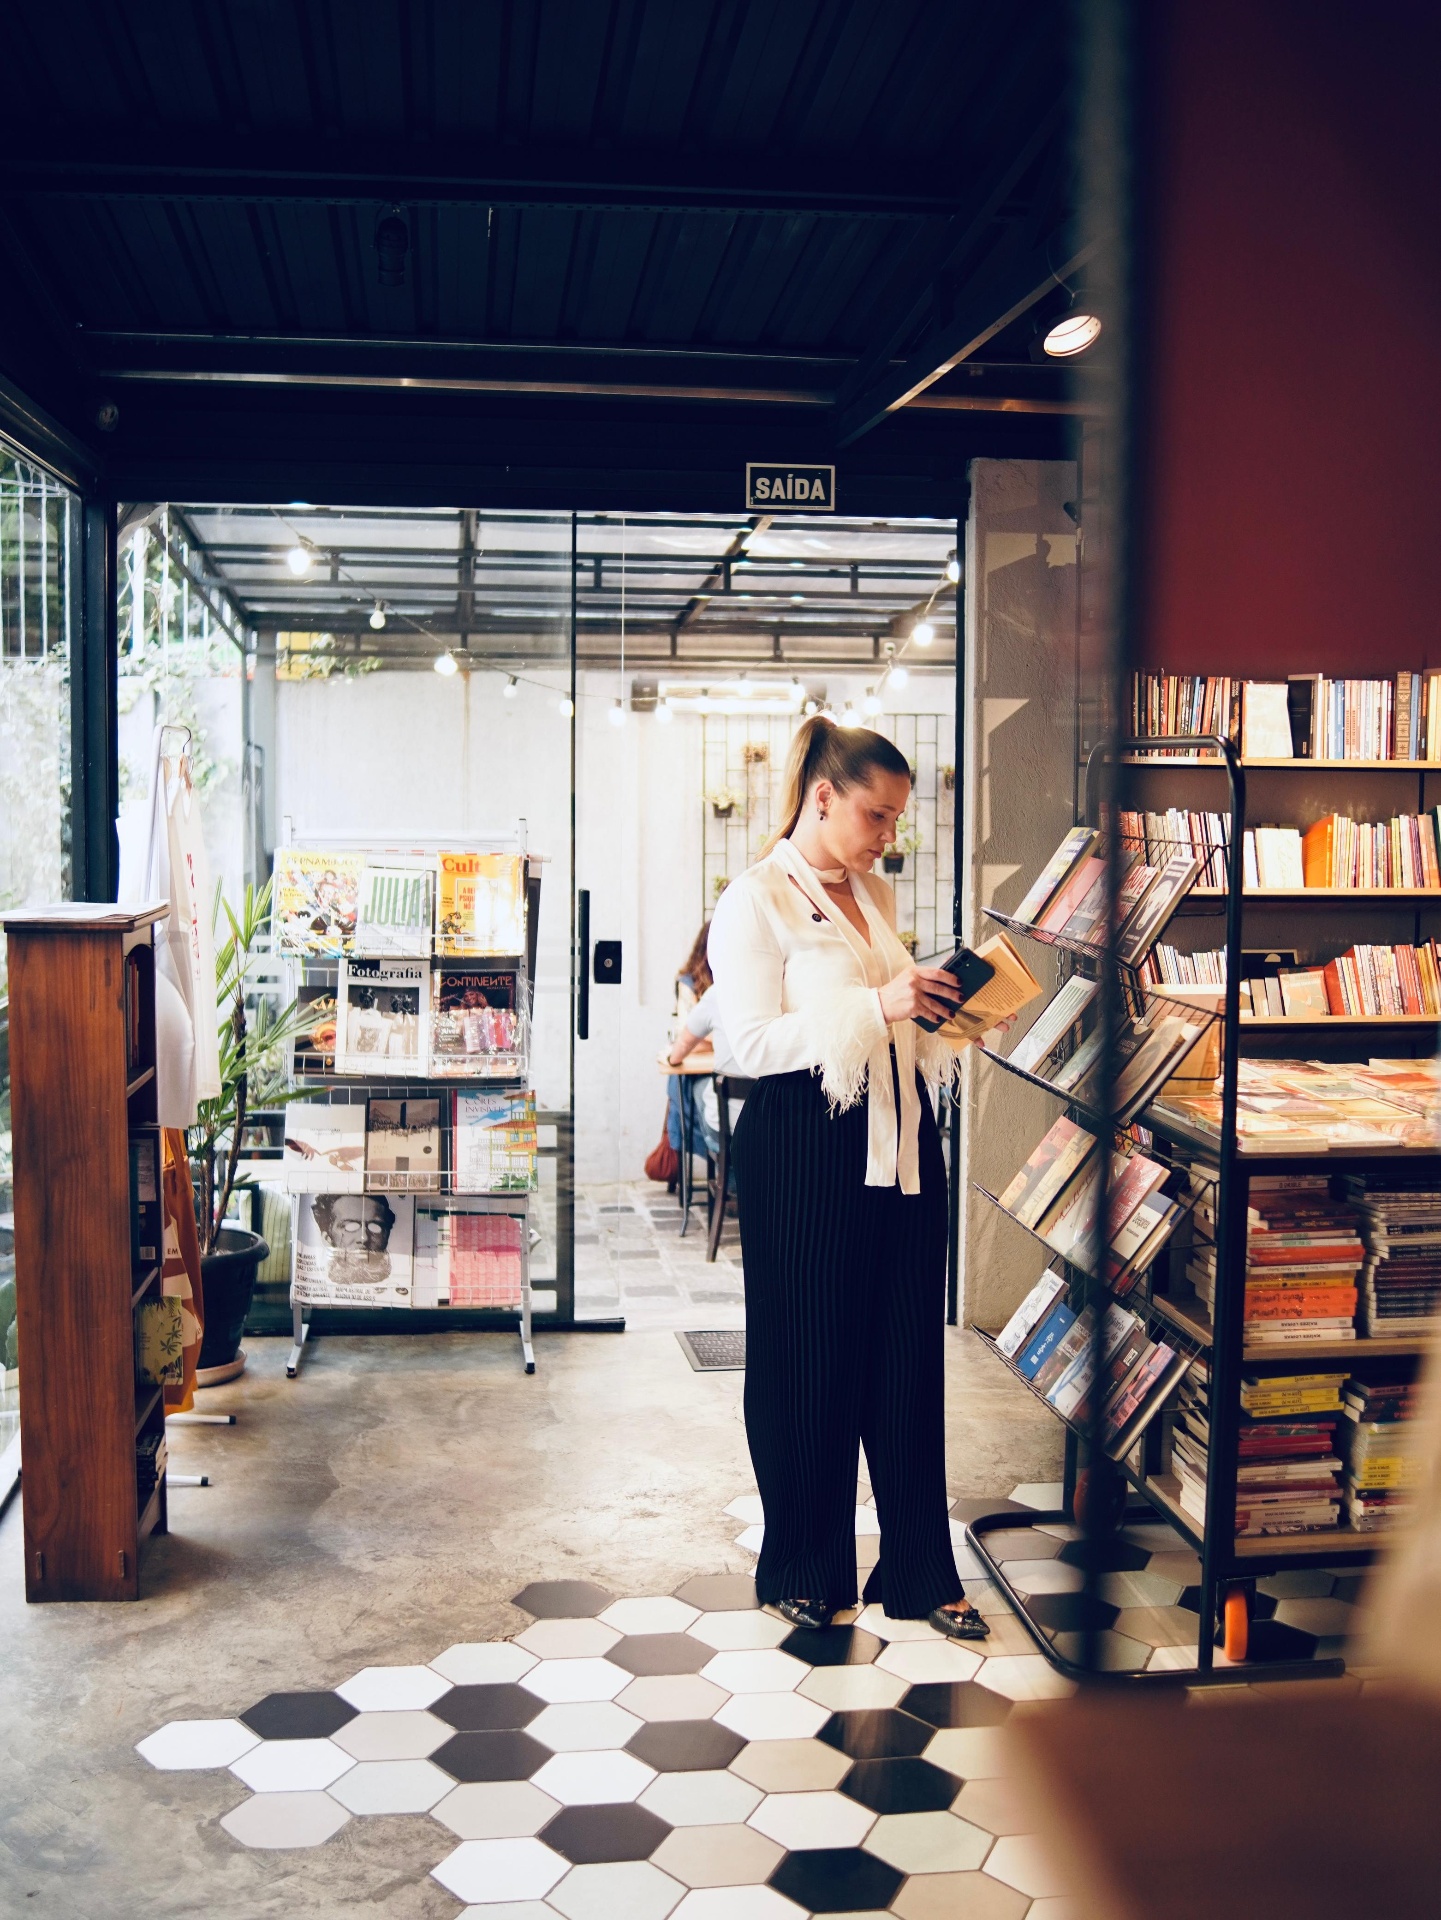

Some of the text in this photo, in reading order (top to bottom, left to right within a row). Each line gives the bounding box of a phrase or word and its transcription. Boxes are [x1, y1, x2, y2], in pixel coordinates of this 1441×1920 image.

[756, 474, 825, 500] SAÍDA
[442, 858, 480, 873] Cult
[348, 964, 422, 981] Fotografia
[440, 976, 513, 987] CONTINENTE
[167, 1247, 179, 1255] EM
